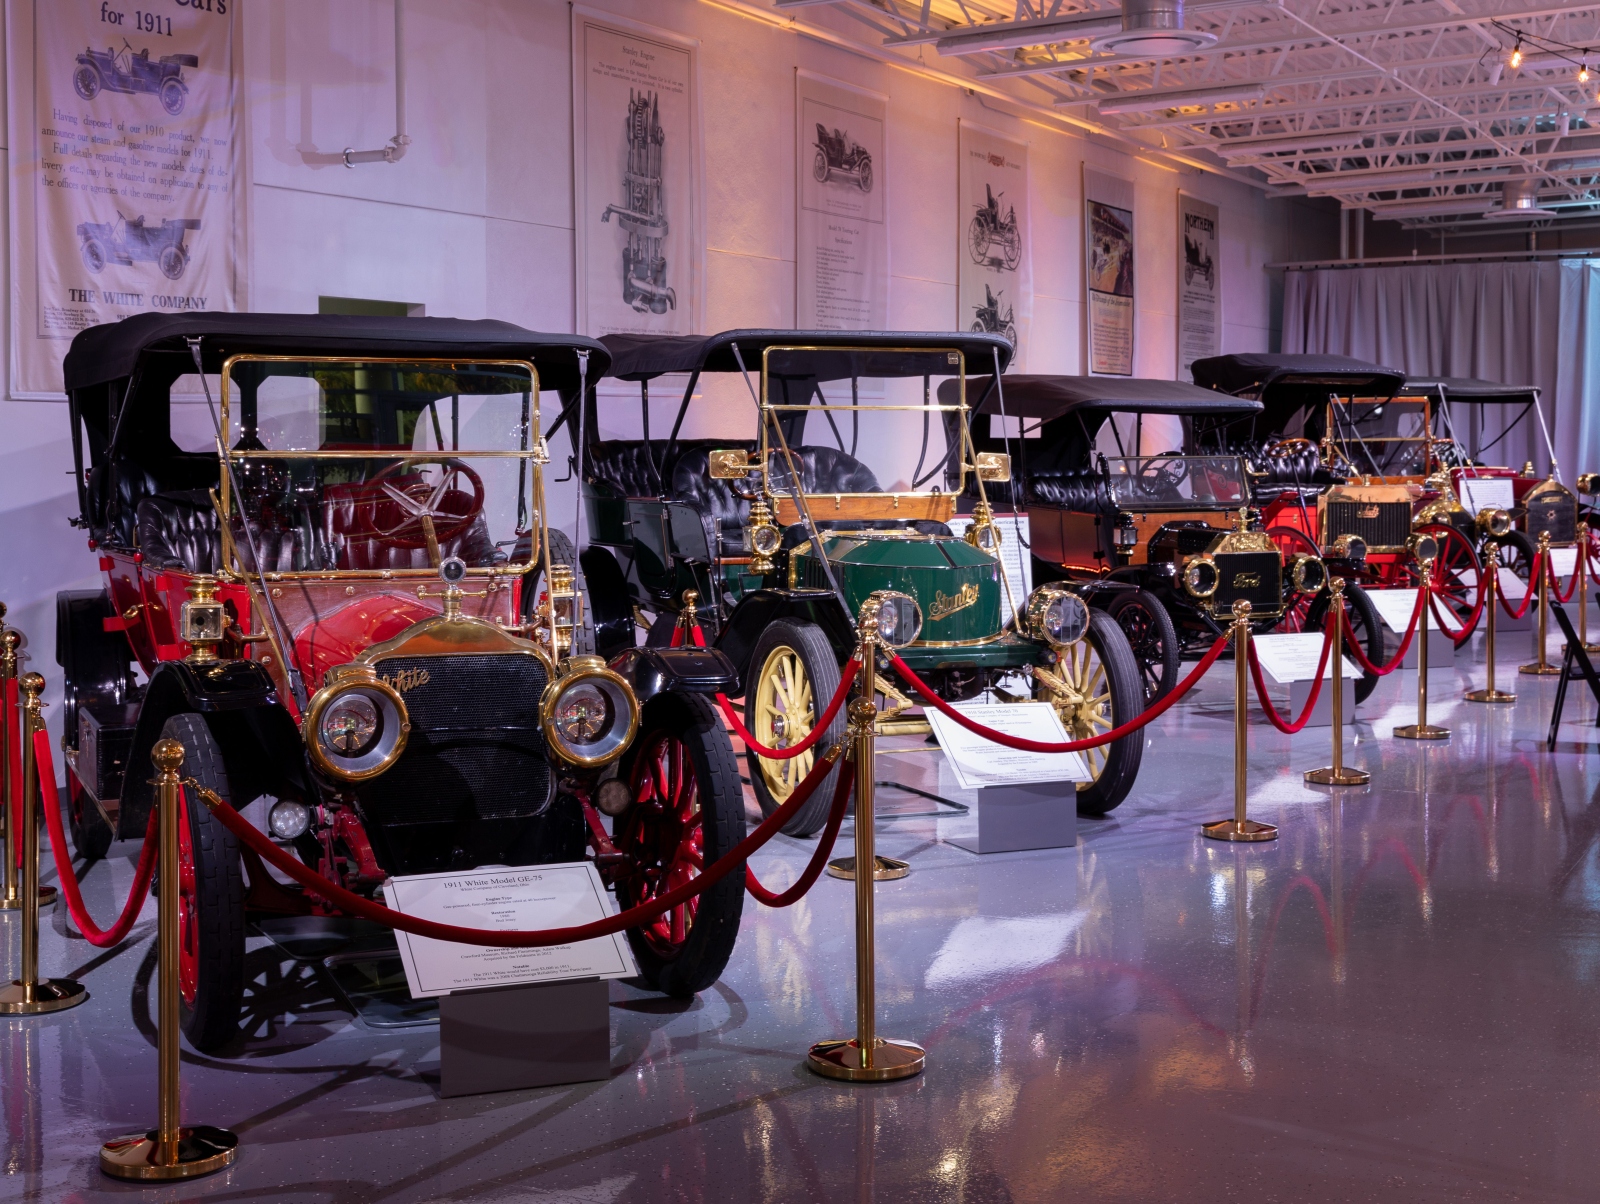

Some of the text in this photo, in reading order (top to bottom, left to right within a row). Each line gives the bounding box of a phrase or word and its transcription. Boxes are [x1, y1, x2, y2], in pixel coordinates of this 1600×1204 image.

[101, 1, 172, 36] for 1911
[175, 0, 226, 14] ars
[53, 108, 77, 125] Having
[83, 114, 112, 130] disposed
[117, 121, 124, 131] of
[145, 125, 164, 136] 1910
[169, 130, 195, 143] product,
[42, 127, 213, 160] announce our steam and gasoline models for 1911.
[53, 142, 68, 154] Full
[72, 148, 92, 159] details
[96, 152, 126, 167] regarding
[130, 155, 140, 165] the
[162, 161, 186, 172] models,
[189, 164, 204, 174] dates
[209, 167, 215, 176] of
[218, 168, 228, 176] de-
[42, 158, 65, 172] livery,
[70, 165, 83, 175] etc.,
[86, 168, 100, 178] may
[105, 167, 113, 178] be
[117, 170, 145, 182] obtained
[160, 176, 194, 189] application
[208, 184, 218, 192] any
[222, 183, 228, 192] of
[42, 175, 54, 186] the
[57, 178, 78, 190] offices
[91, 184, 118, 195] agencies
[121, 186, 127, 195] of
[130, 188, 140, 198] the
[143, 192, 174, 203] company.
[1185, 213, 1214, 239] NORTHERN
[69, 289, 207, 309] THE WHITE COMPANY
[1233, 572, 1261, 589] Ford
[928, 583, 979, 620] Stanley
[383, 667, 430, 694] hite
[465, 878, 488, 887] White
[491, 876, 516, 885] Model
[517, 875, 543, 883] GE-75
